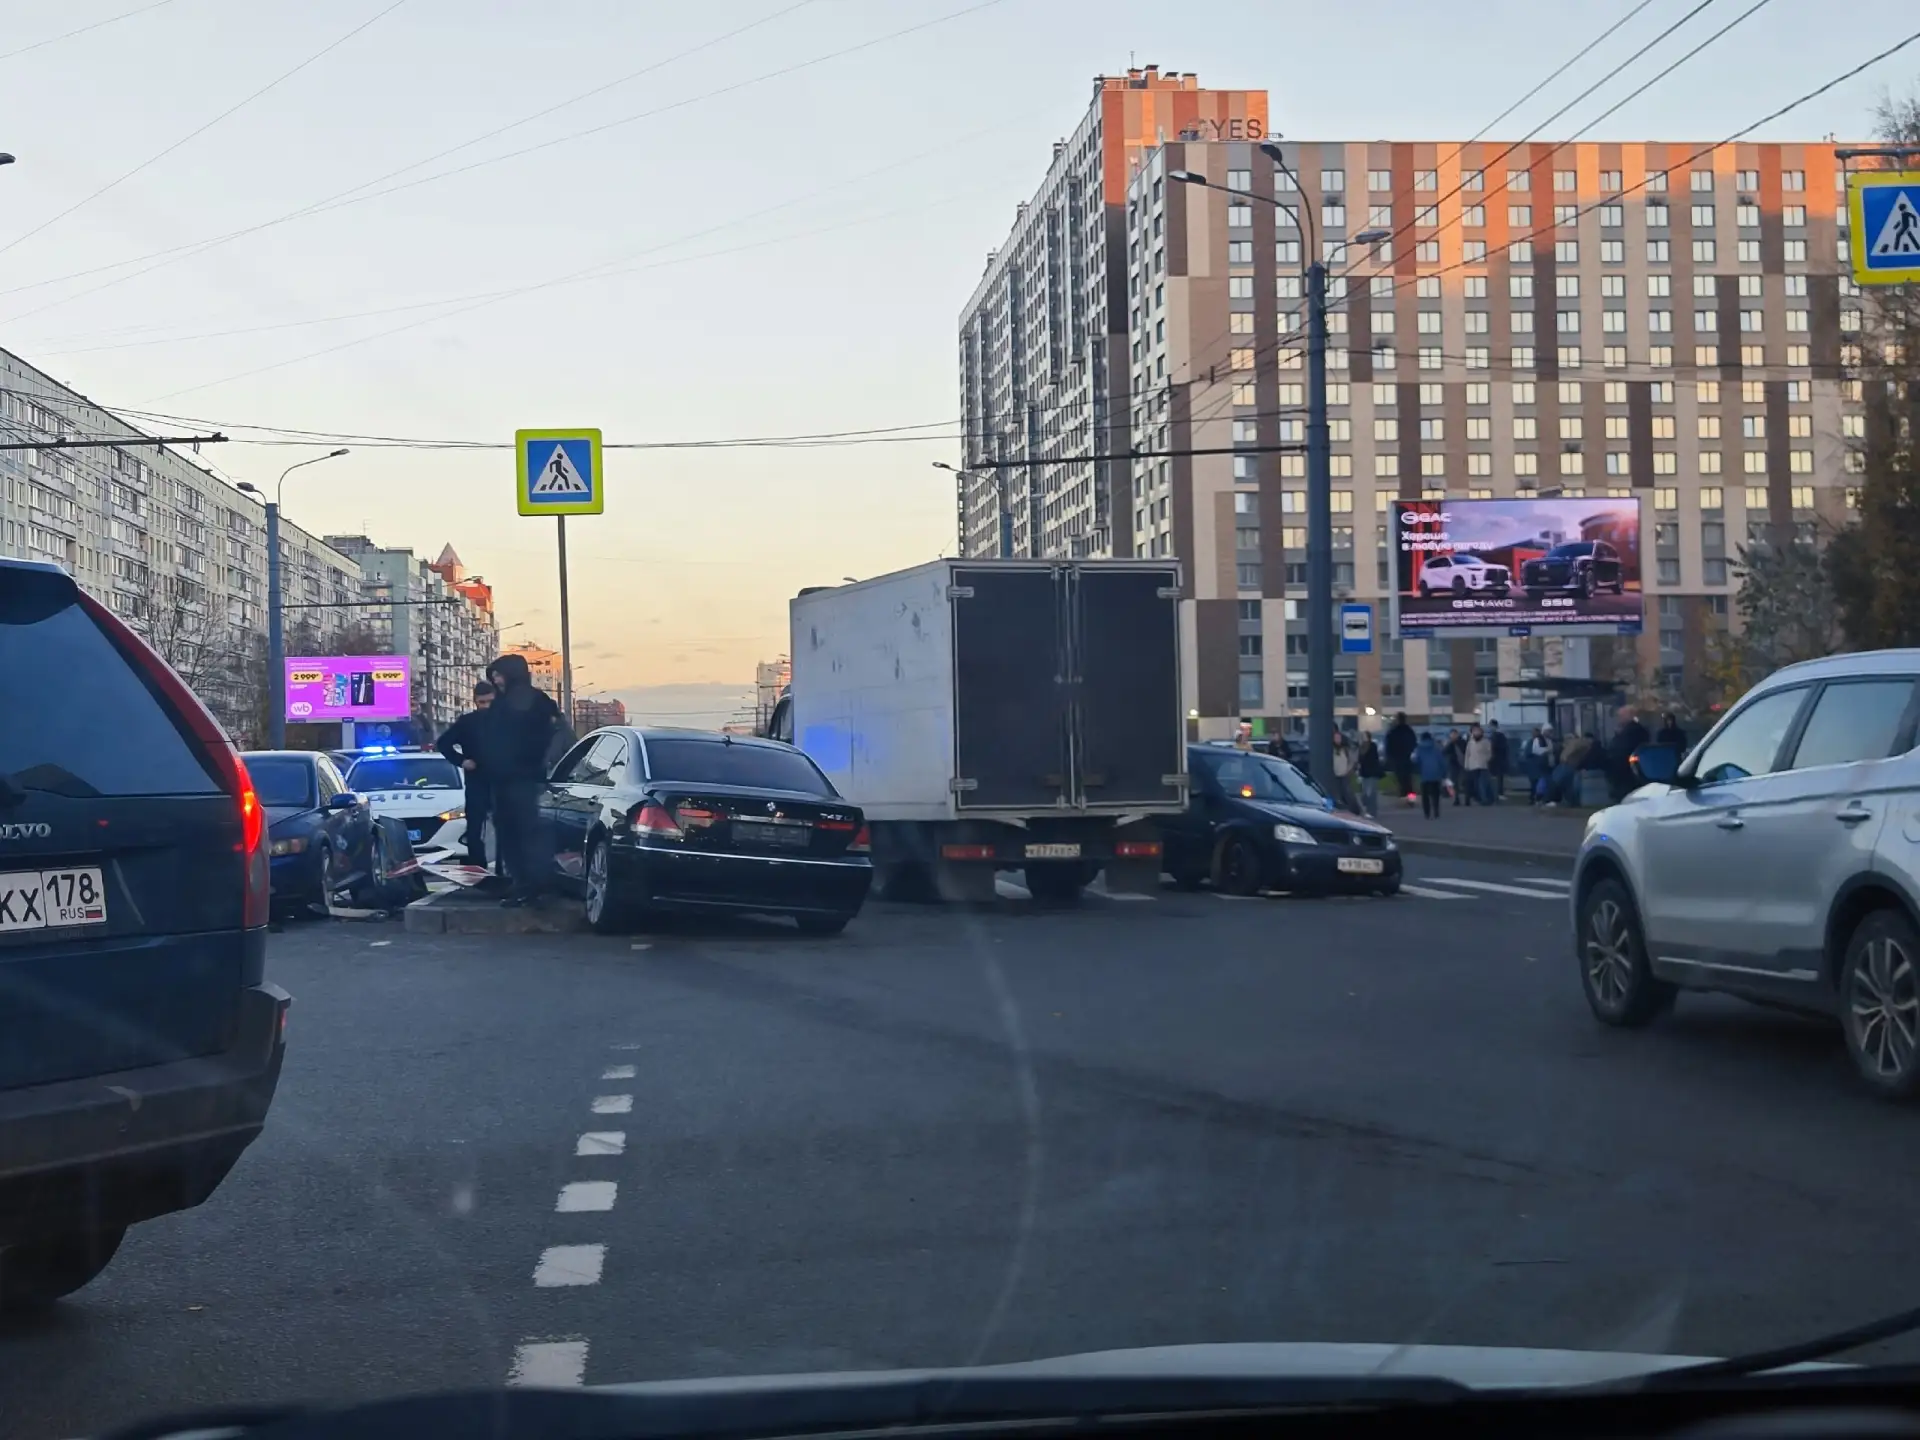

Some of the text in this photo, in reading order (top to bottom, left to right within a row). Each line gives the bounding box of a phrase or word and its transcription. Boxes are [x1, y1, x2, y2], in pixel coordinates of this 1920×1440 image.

[1210, 118, 1262, 139] YES
[46, 873, 94, 908] 178
[60, 907, 85, 920] RUS
